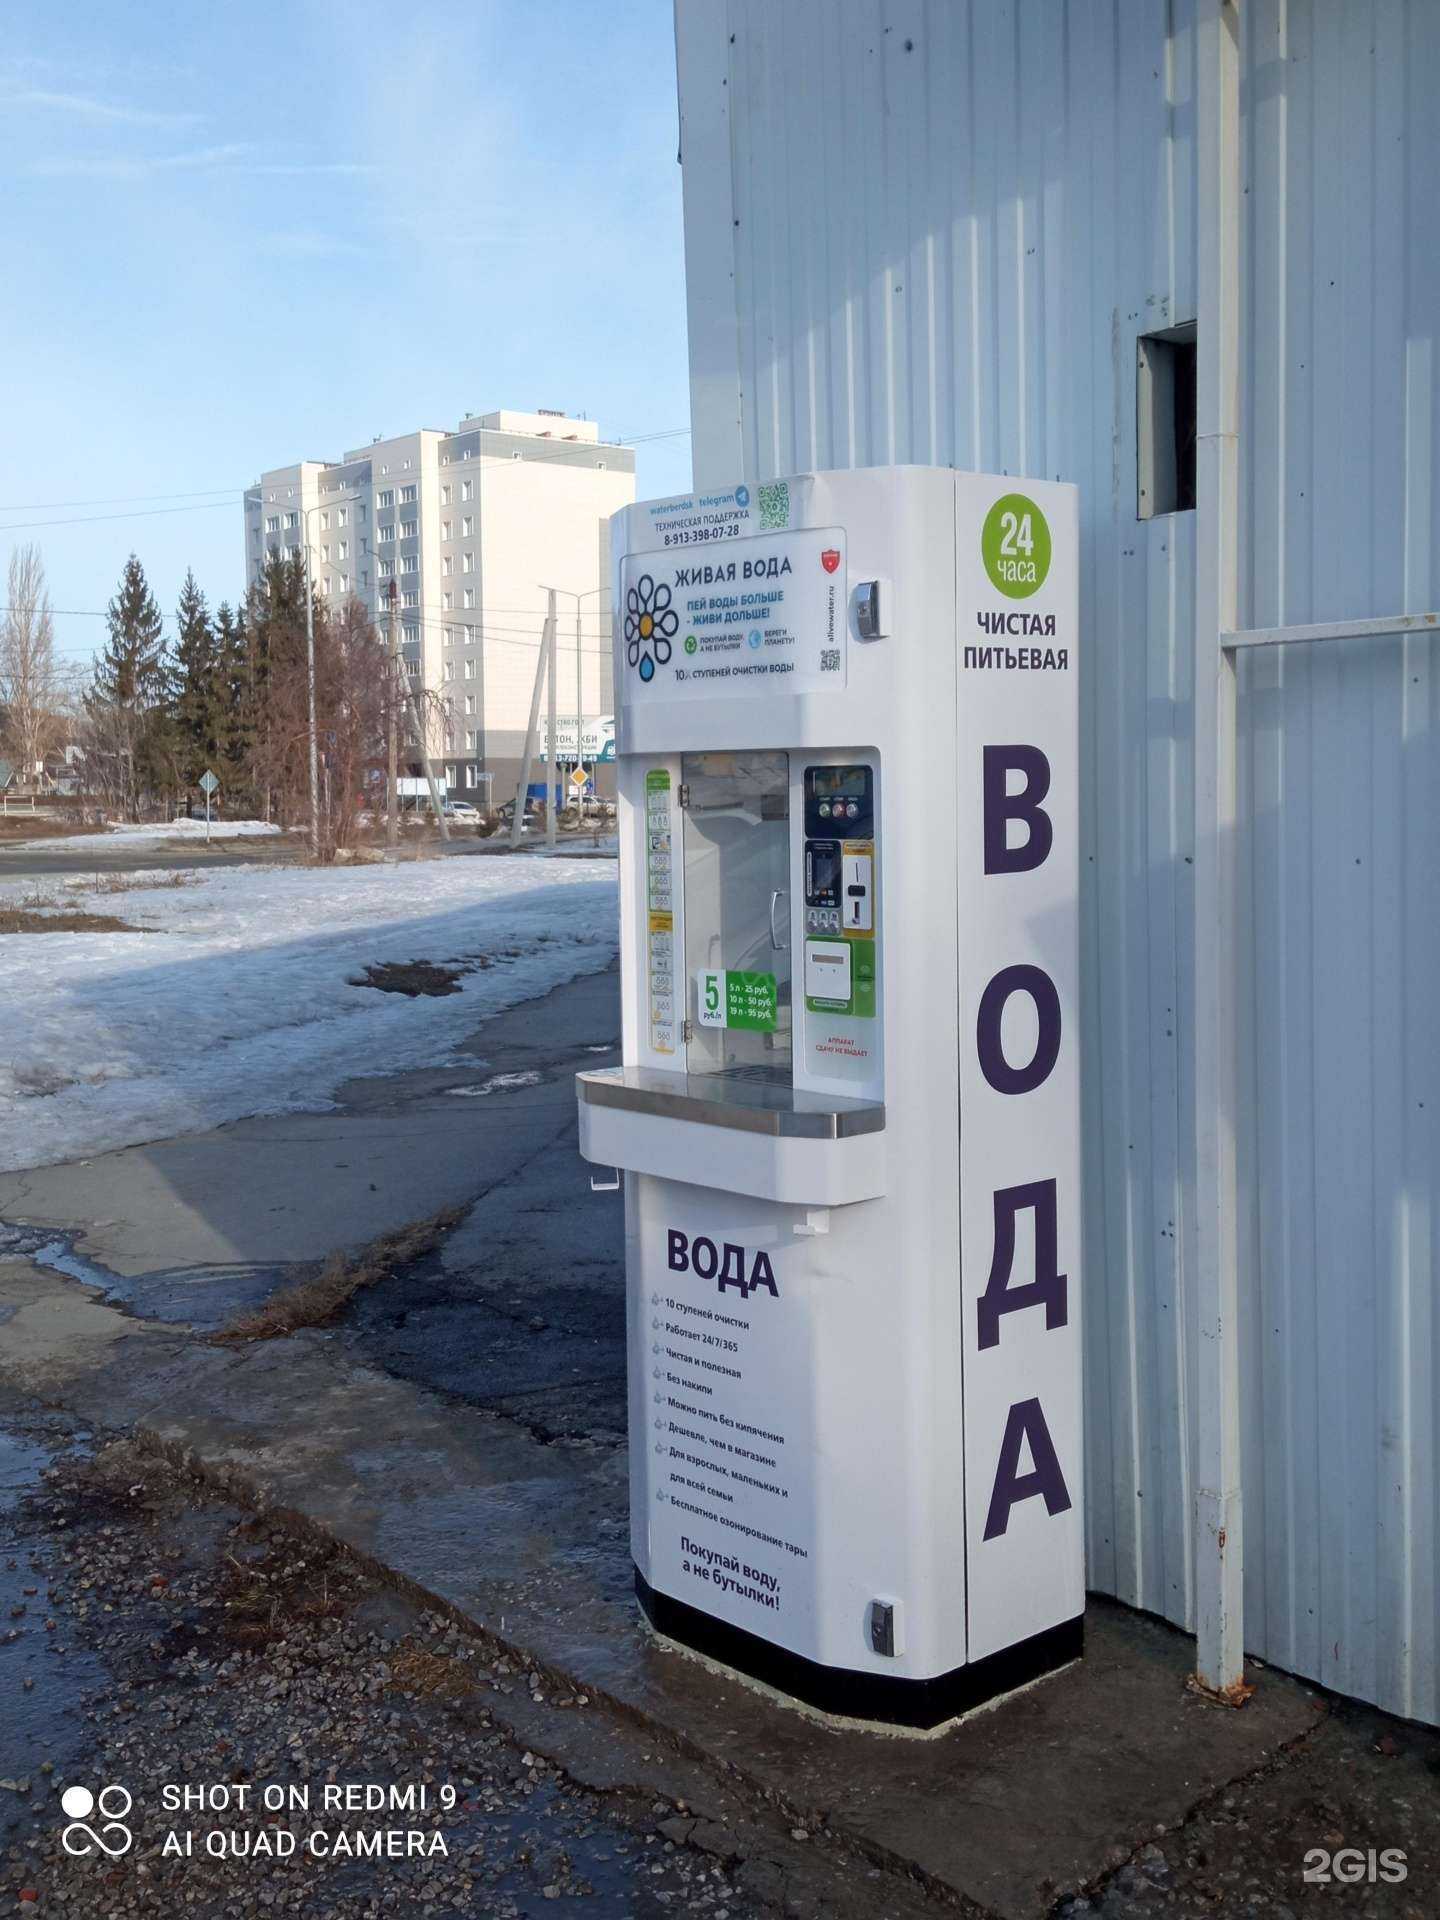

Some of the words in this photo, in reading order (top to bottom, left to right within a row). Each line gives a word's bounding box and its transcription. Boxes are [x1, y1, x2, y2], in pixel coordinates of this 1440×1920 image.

[699, 493, 735, 507] telegram
[655, 516, 702, 532] ТЕХНИЧЕСКАЯ
[703, 509, 749, 524] ПОДДЕРЖКА
[664, 524, 739, 546] 8-913-398-07-28
[1000, 511, 1034, 556] 24
[675, 563, 736, 588] ЖИВАЯ
[743, 556, 792, 579] ВОДА
[997, 560, 1036, 583] часа
[687, 598, 707, 612] ПЕЙ
[709, 595, 738, 609] ВОДЫ
[740, 591, 784, 605] БОЛЬШЕ
[692, 612, 722, 626] ЖИВИ
[724, 608, 770, 625] ДОЛЬШЕ!
[977, 611, 1056, 636] ЧИСТАЯ
[764, 629, 787, 637] БЕРЕГИ
[692, 667, 731, 679] СТУПЕНЕЙ
[732, 665, 768, 676] ОЧИСТКИ
[769, 663, 794, 673] ВОДЫ
[964, 646, 1068, 670] ПИТЬЕВАЯ
[705, 976, 719, 1011] 5
[729, 983, 735, 991] 5
[729, 994, 737, 1003] 10
[748, 997, 757, 1005] 50
[976, 744, 1072, 1541] ВОДА
[668, 1228, 779, 1299] ВОДА
[665, 1298, 675, 1309] 10
[676, 1302, 713, 1320] ступеней
[714, 1314, 749, 1330] очистки
[665, 1322, 700, 1341] Работает
[702, 1333, 738, 1353] 24/7/365
[666, 1347, 693, 1364] Чистая
[694, 1358, 700, 1366] и
[701, 1360, 742, 1379] полезная
[667, 1372, 681, 1385] Без
[682, 1379, 712, 1396] накипи
[668, 1397, 697, 1415] Можно
[698, 1408, 718, 1422] пить
[719, 1414, 734, 1428] без
[735, 1422, 785, 1445] кипячения
[669, 1421, 708, 1444] Дешевле,
[709, 1438, 726, 1451] чем
[727, 1444, 733, 1452] в
[734, 1446, 776, 1468] магазине
[669, 1446, 685, 1460] Для
[686, 1453, 729, 1477] взрослых,
[731, 1471, 780, 1496] маленьких
[782, 1489, 788, 1498] и
[670, 1473, 685, 1485] для
[687, 1478, 706, 1494] всей
[707, 1486, 734, 1503] семьи
[671, 1496, 718, 1522] Бесплатное
[720, 1516, 784, 1548] озонирование
[785, 1542, 808, 1558] тары
[681, 1536, 740, 1573] Покупай
[743, 1564, 780, 1593] воду,
[682, 1560, 690, 1572] а
[694, 1563, 710, 1580] не
[712, 1569, 780, 1611] бутылки!
